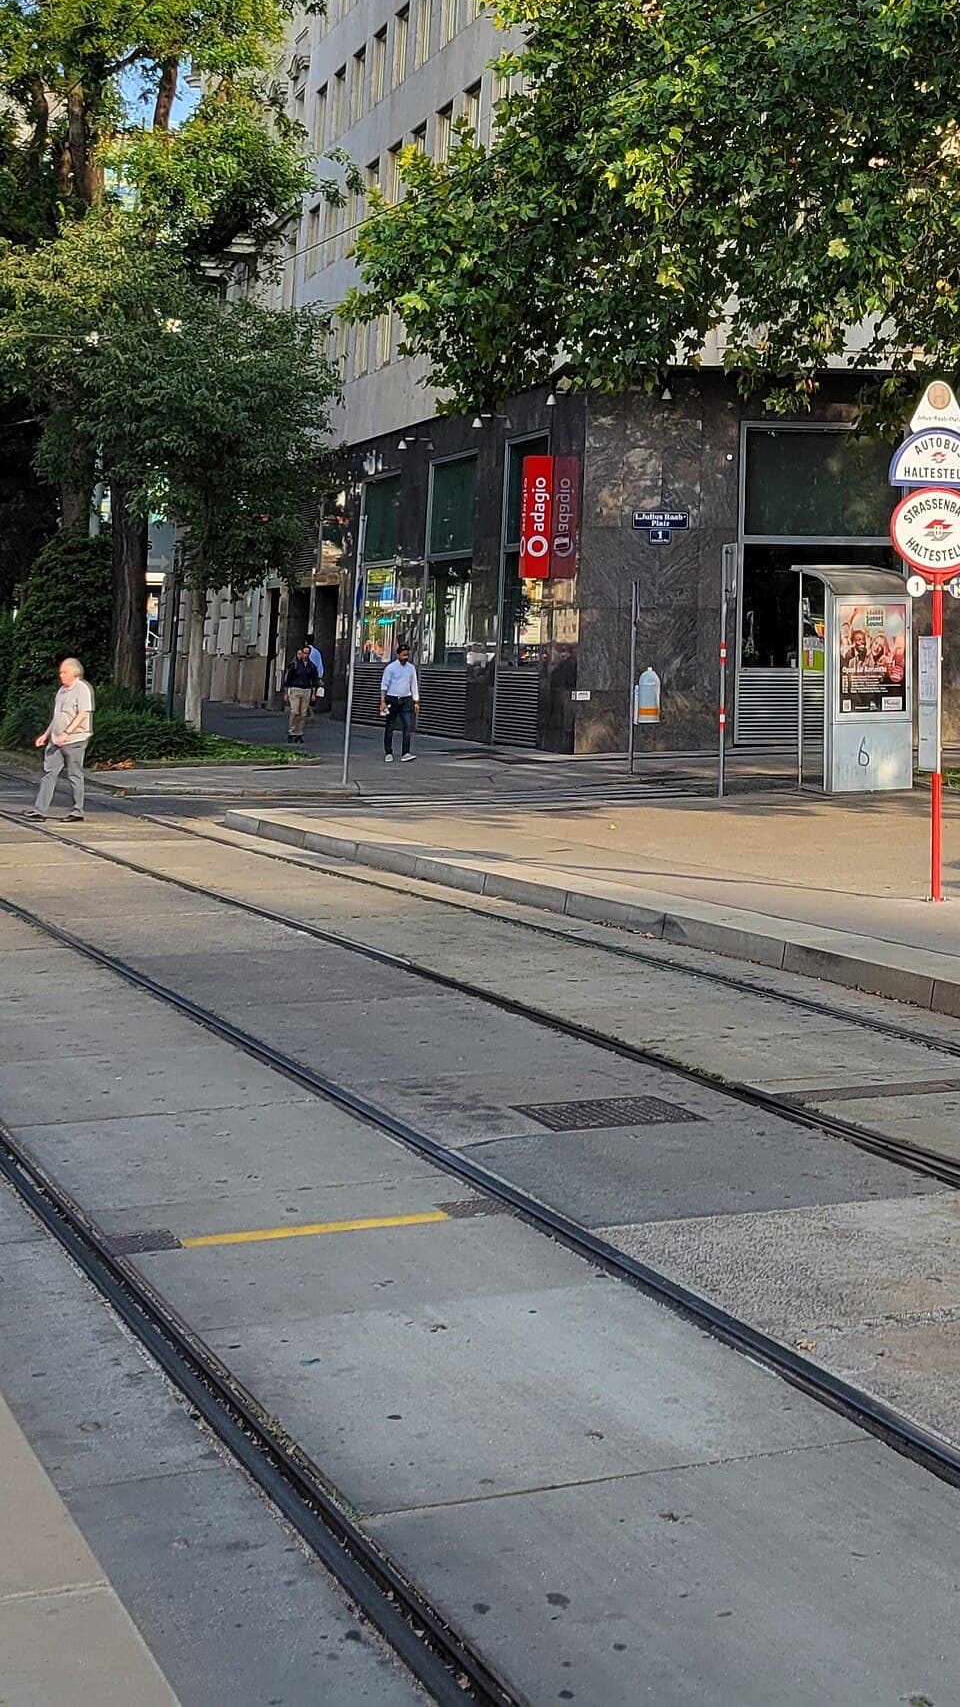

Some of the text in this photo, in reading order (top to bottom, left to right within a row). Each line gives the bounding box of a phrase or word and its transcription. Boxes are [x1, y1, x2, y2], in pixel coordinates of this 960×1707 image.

[530, 477, 550, 532] adagio
[657, 531, 663, 539] 1
[913, 581, 919, 592] 1
